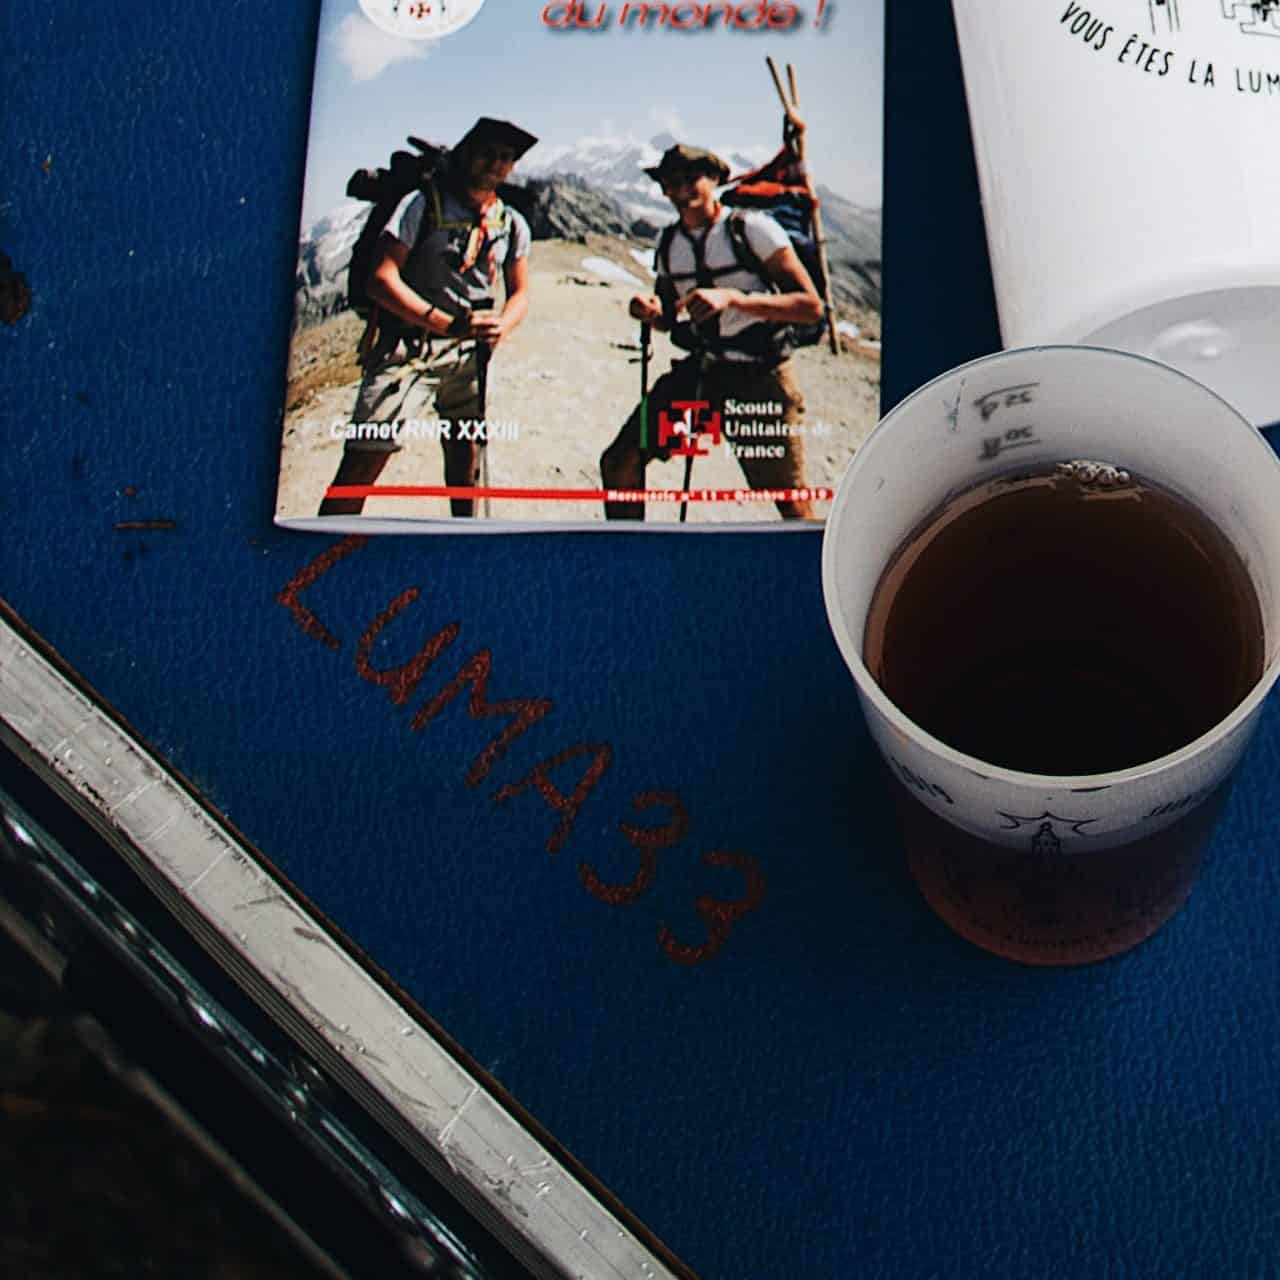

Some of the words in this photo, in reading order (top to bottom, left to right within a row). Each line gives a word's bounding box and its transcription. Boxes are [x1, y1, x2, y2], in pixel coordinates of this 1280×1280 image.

[1060, 0, 1115, 51] VOUS
[1118, 33, 1175, 78] ÊTES
[1188, 60, 1216, 89] LA
[724, 399, 783, 415] Scouts
[276, 534, 767, 966] LUMA33
